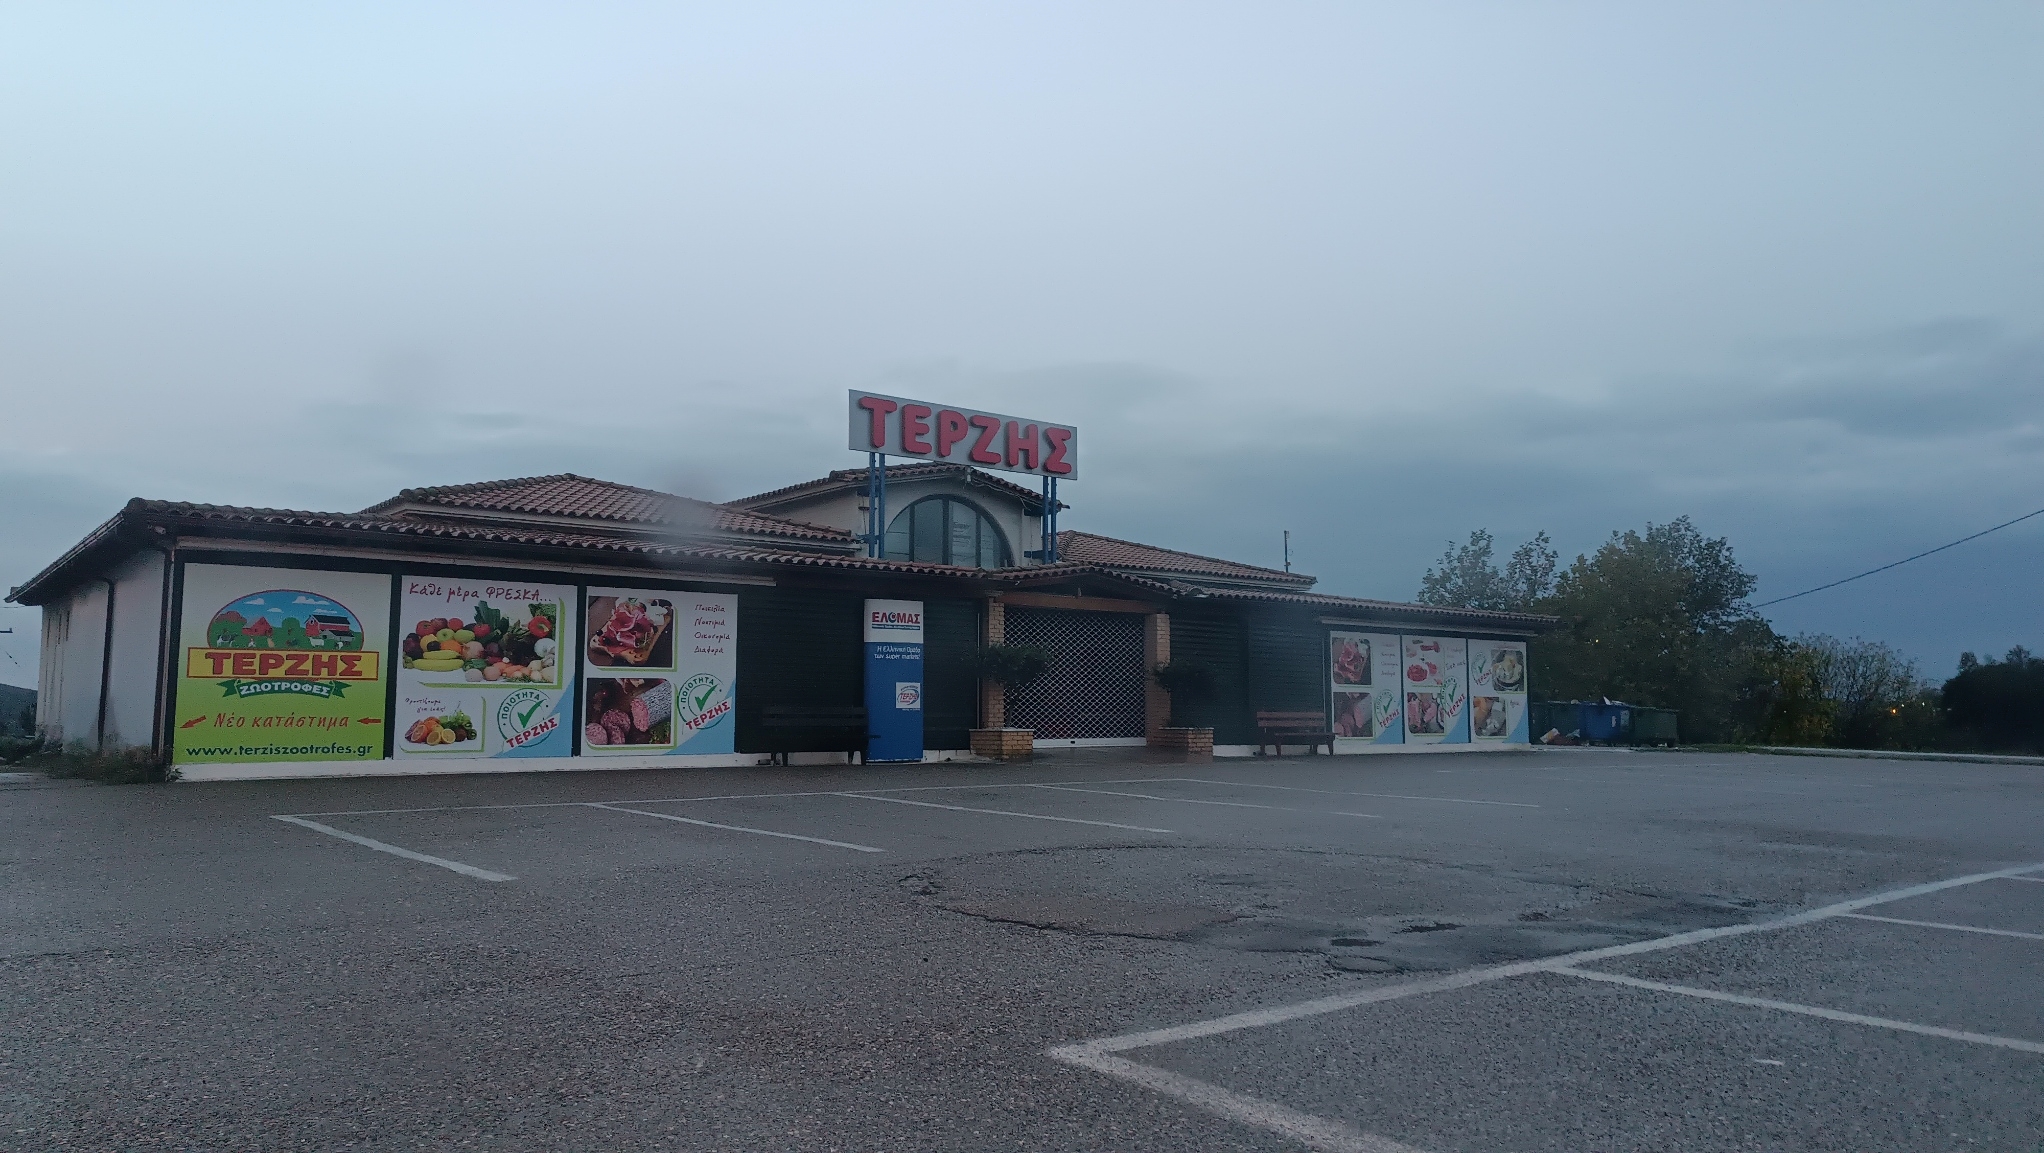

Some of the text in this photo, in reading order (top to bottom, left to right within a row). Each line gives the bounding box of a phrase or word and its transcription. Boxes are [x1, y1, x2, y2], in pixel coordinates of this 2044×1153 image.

[859, 396, 1072, 474] ΤΕΡΖΗΣ
[409, 582, 552, 603] Κάθε μέρα ΦΡΕΣΚΑ...
[205, 652, 363, 677] ΤΕΡΖΗΣ
[239, 681, 331, 696] ΖΩΟΤΡΟΦΕΣ
[680, 676, 715, 703] ΠΟΙΟΤΗΤΑ
[501, 691, 540, 719] ΠΟΙΟΤΗΤΑ
[685, 701, 731, 730] ΤΕΡΖΗΣ
[213, 711, 350, 731] Νέο κατάστημα
[506, 717, 557, 748] ΤΕΡΖΗΣ
[186, 743, 374, 757] www.terziszootrofes.gr
